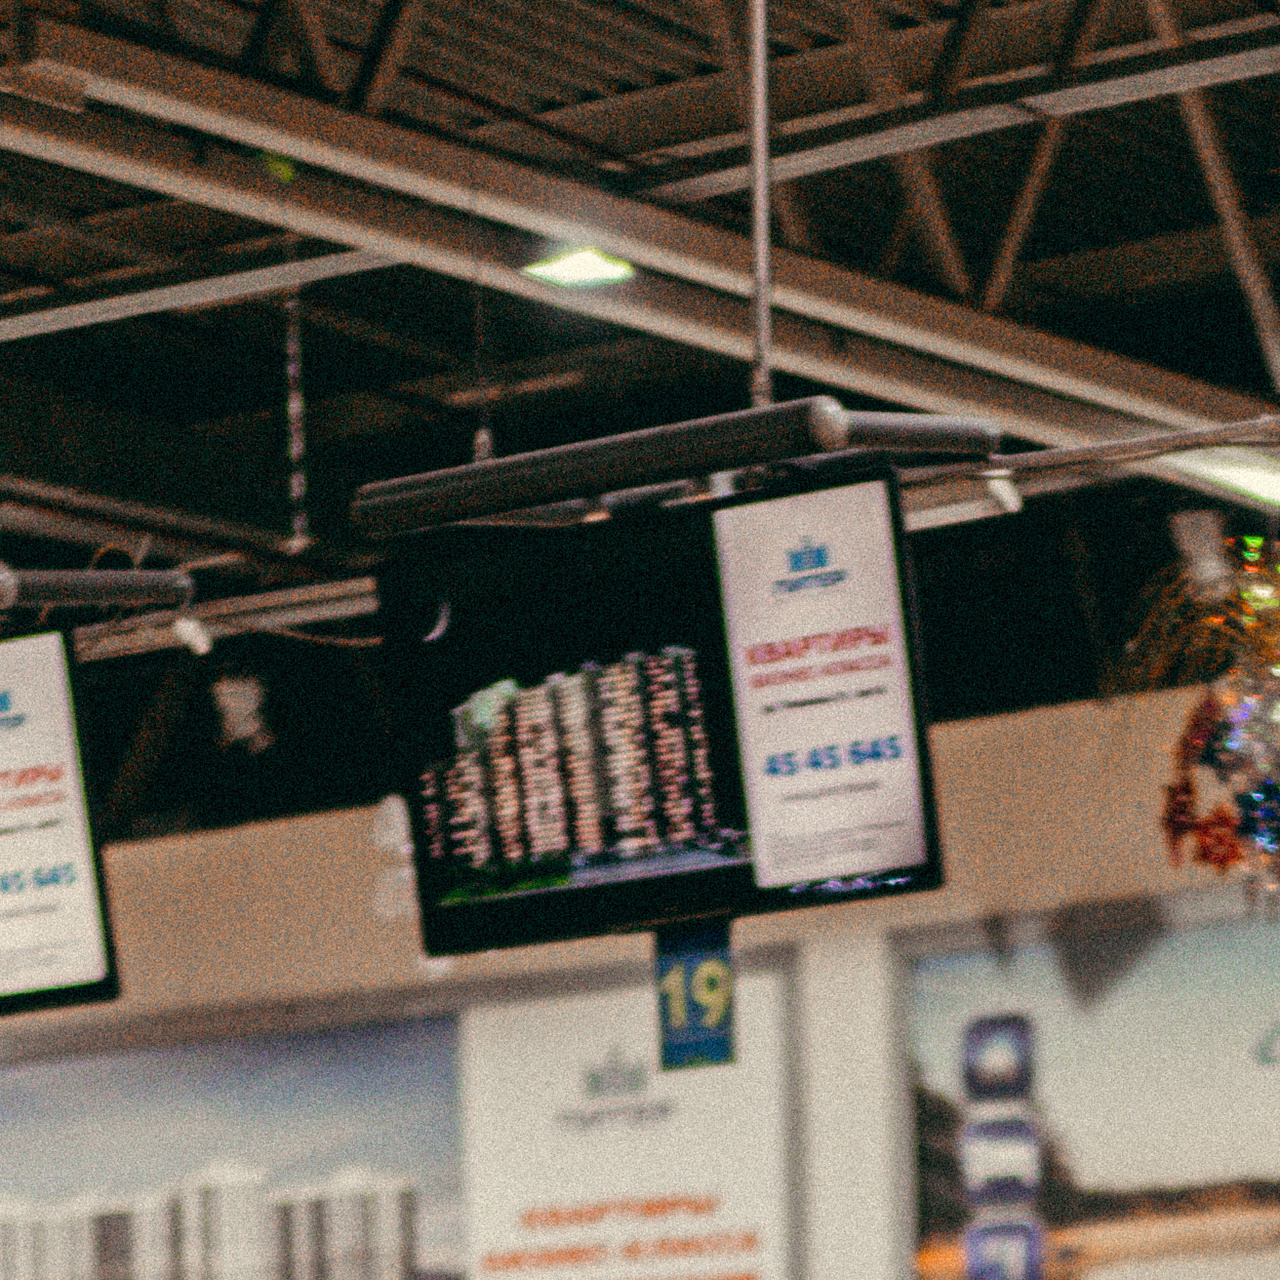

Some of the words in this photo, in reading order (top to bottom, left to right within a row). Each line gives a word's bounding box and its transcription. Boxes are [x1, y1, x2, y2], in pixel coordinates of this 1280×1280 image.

[765, 748, 800, 777] 45
[807, 742, 842, 772] 45
[657, 956, 737, 1031] 19
